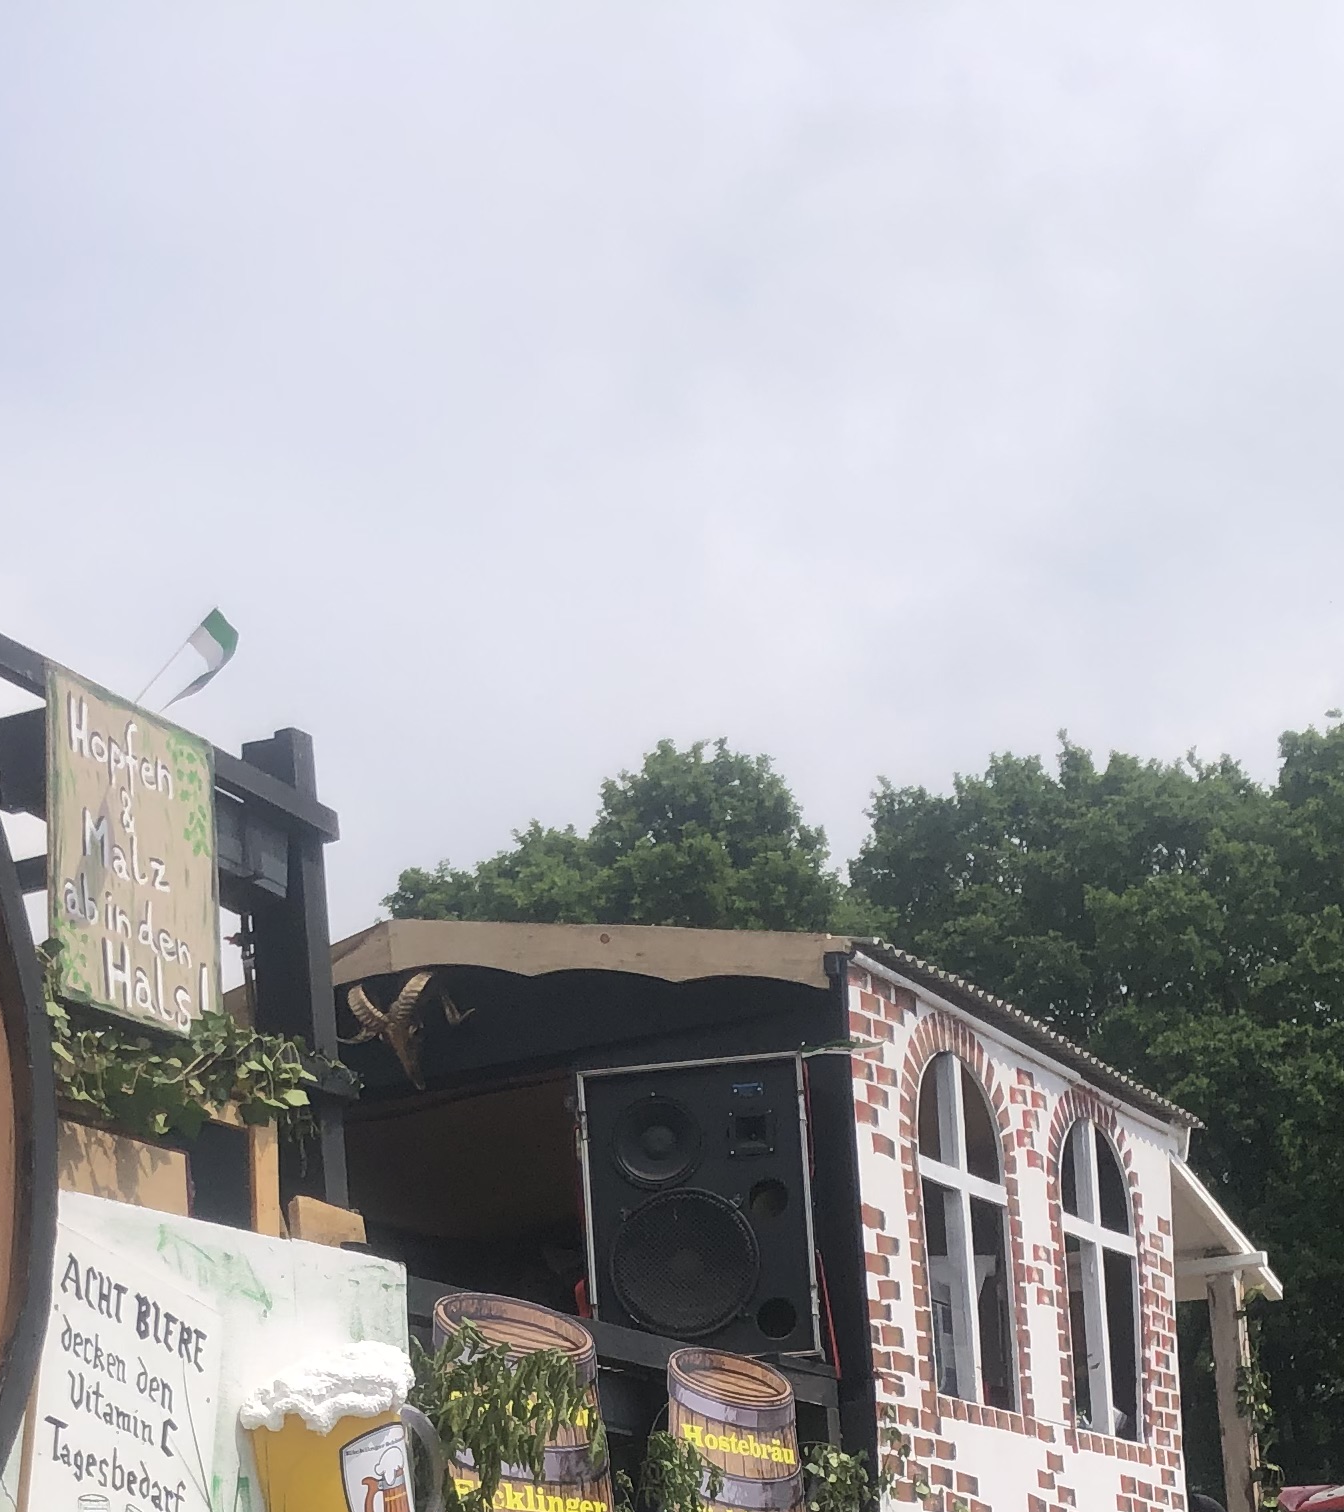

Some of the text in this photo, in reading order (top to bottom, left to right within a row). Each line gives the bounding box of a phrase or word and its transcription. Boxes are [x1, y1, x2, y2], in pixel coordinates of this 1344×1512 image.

[67, 690, 174, 799] Hopfen
[82, 807, 170, 893] Malz
[64, 873, 192, 968] ab in den
[60, 1252, 207, 1373] ACHT BIERE
[61, 1314, 174, 1414] decken den
[67, 1369, 178, 1457] Vitamin C
[681, 1423, 796, 1465] Hostebräu
